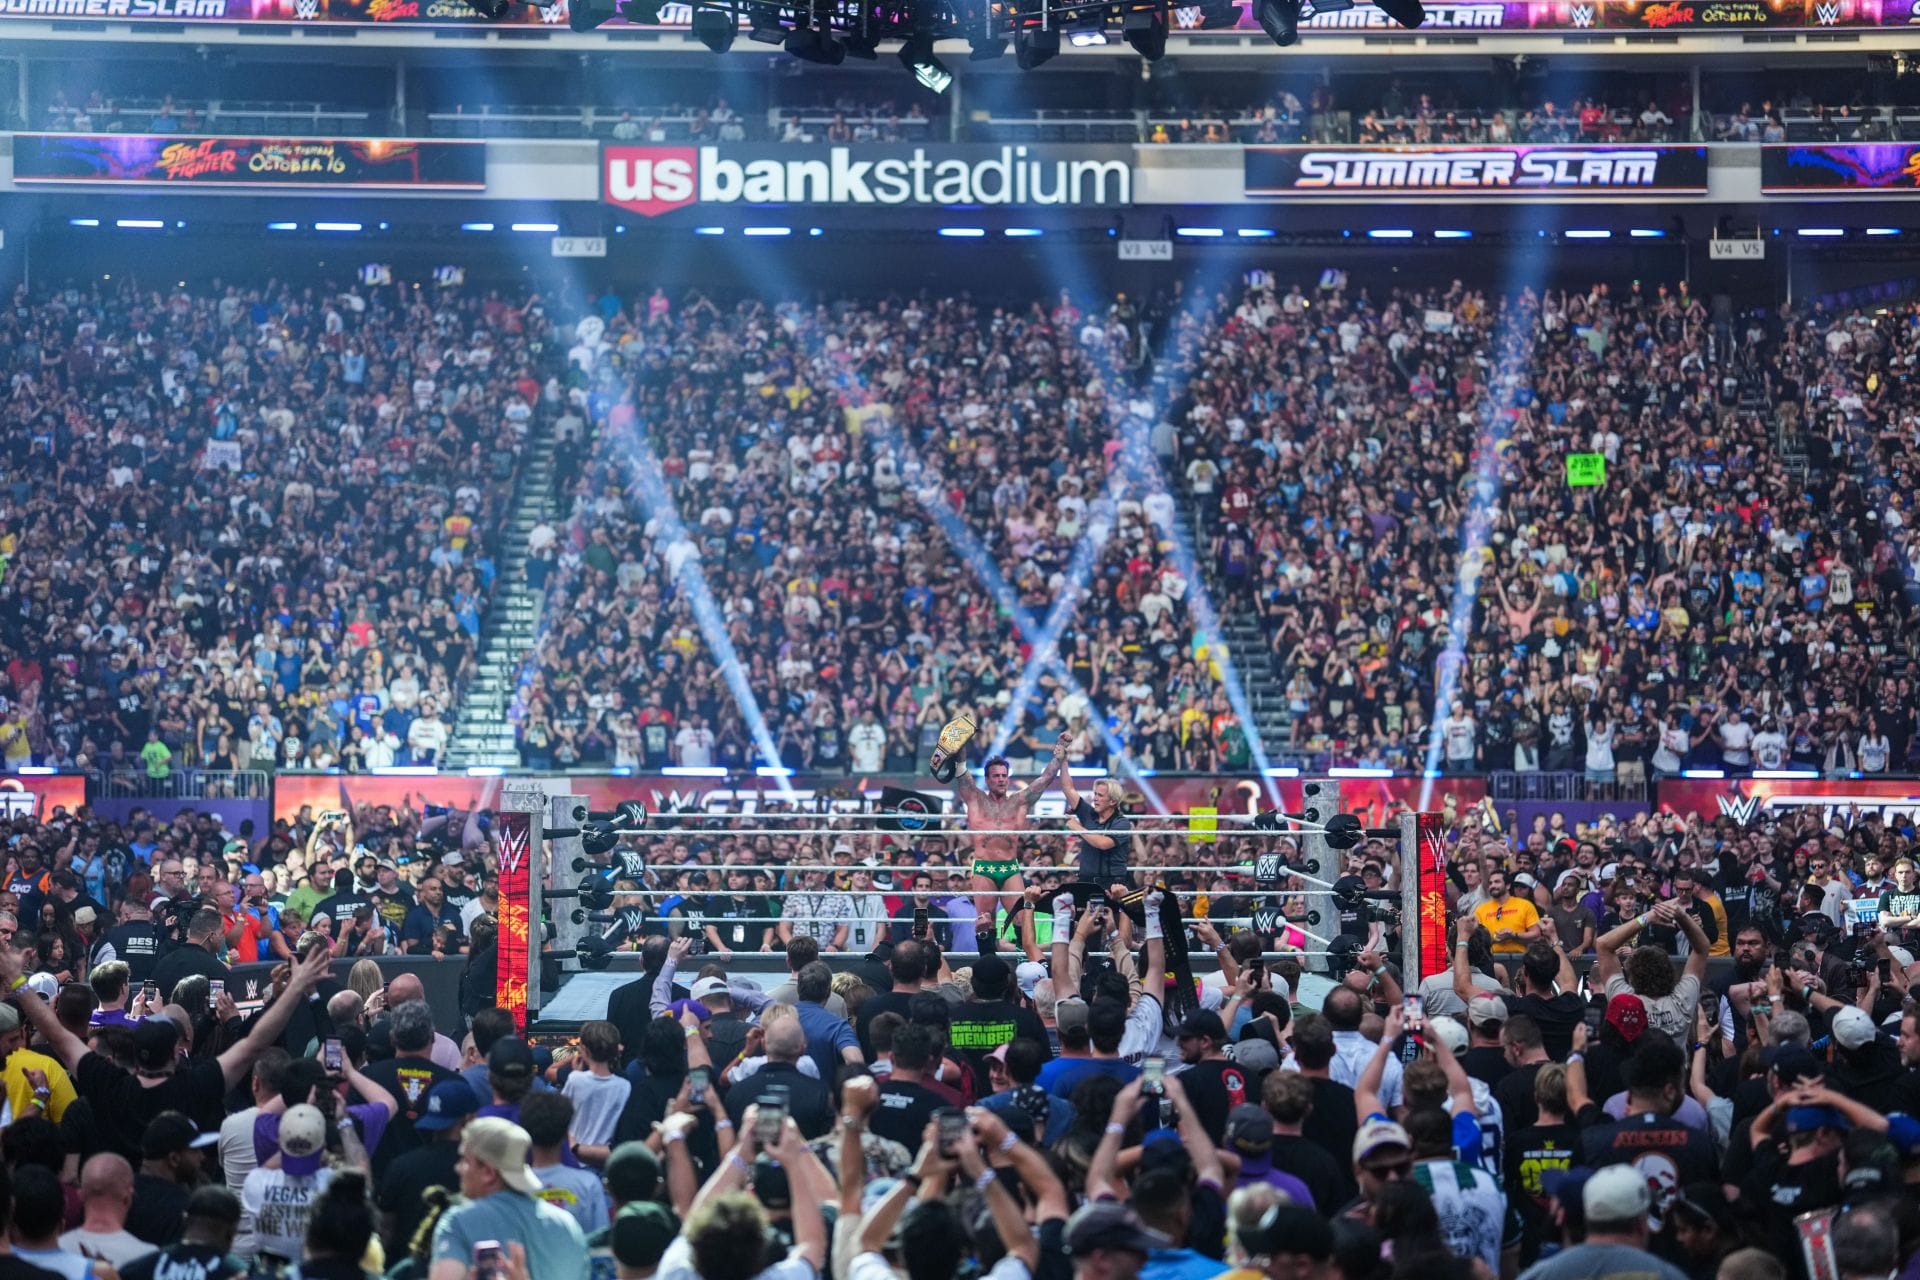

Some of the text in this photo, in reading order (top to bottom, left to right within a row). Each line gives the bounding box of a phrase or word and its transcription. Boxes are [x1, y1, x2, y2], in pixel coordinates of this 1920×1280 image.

[557, 240, 575, 252] V2
[1122, 243, 1167, 256] V3 V4
[1715, 243, 1733, 255] V4
[264, 1185, 309, 1203] VEGAS
